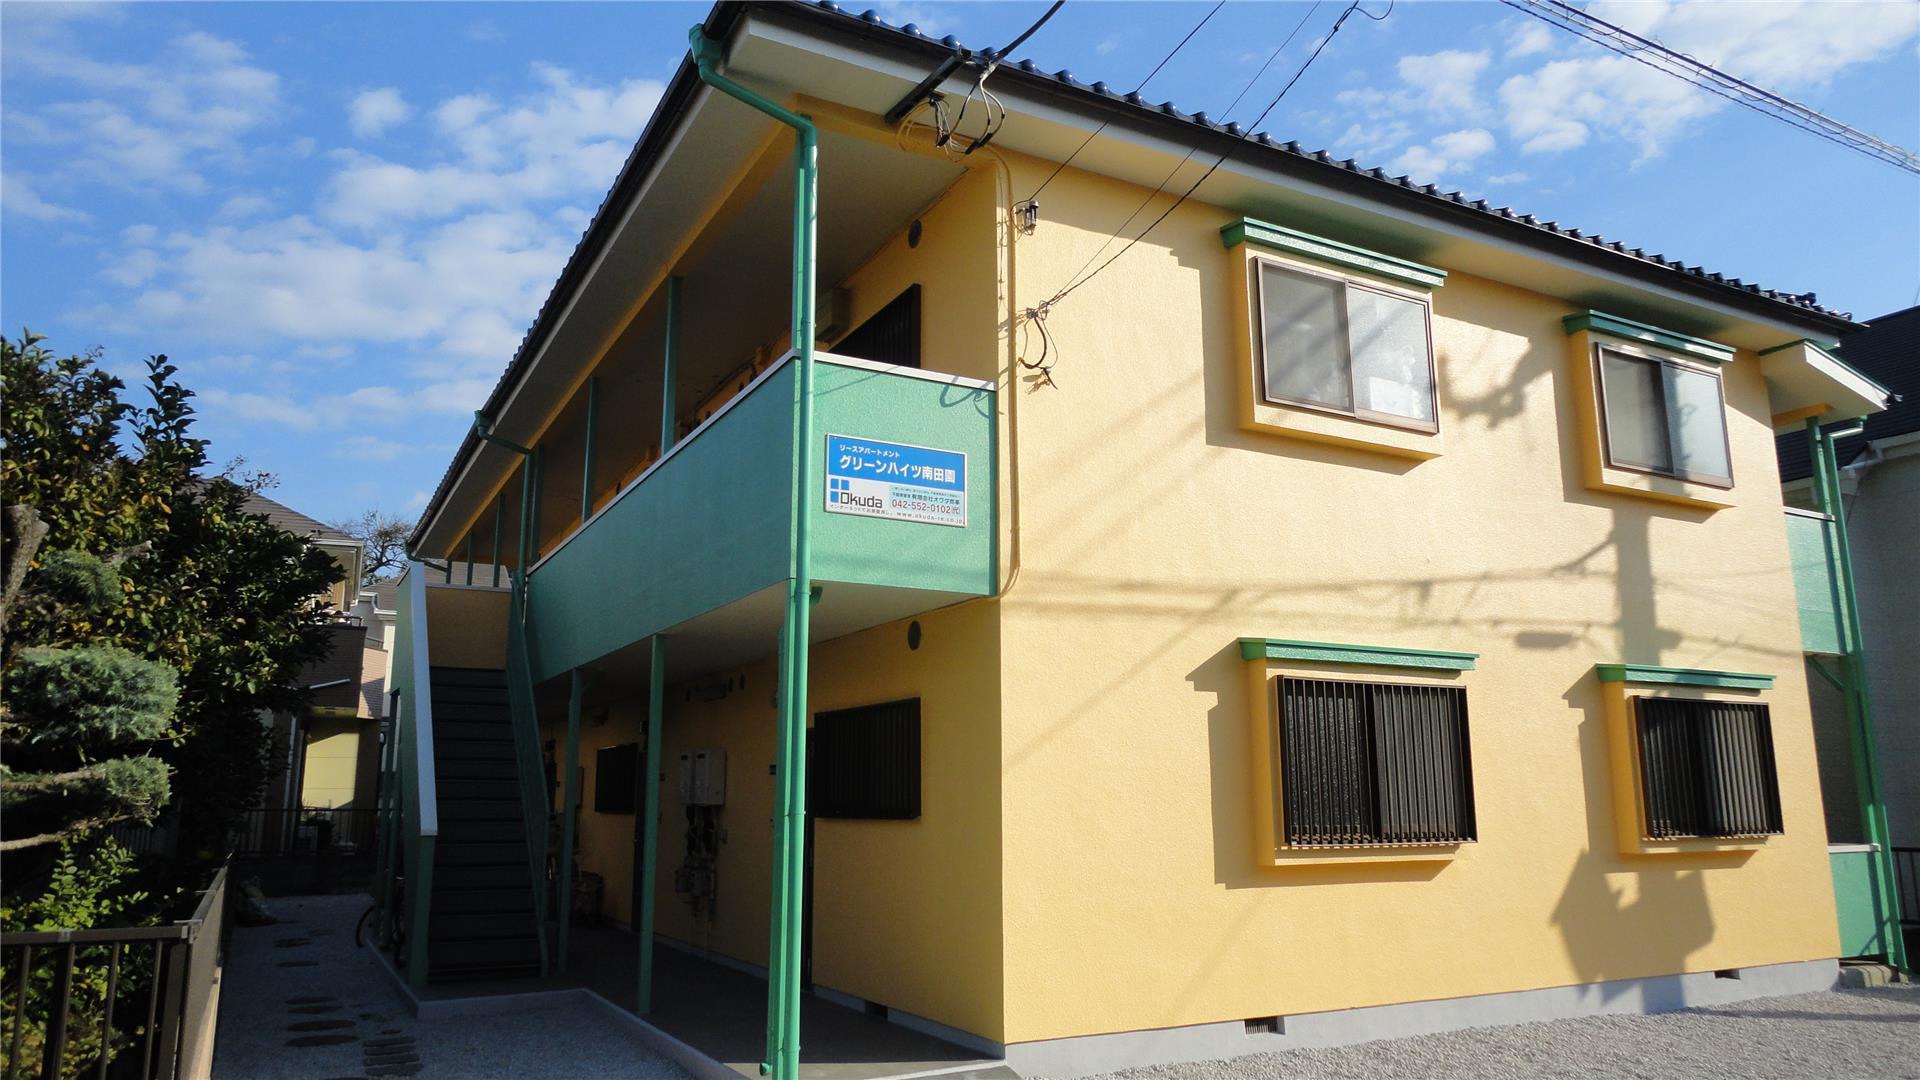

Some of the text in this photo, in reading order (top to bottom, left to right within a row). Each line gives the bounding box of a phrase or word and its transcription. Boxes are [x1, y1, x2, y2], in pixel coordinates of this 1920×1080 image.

[840, 444, 900, 458] リースアパートメント
[840, 455, 955, 483] グリーンハイツ南田園
[840, 492, 883, 508] Okuda
